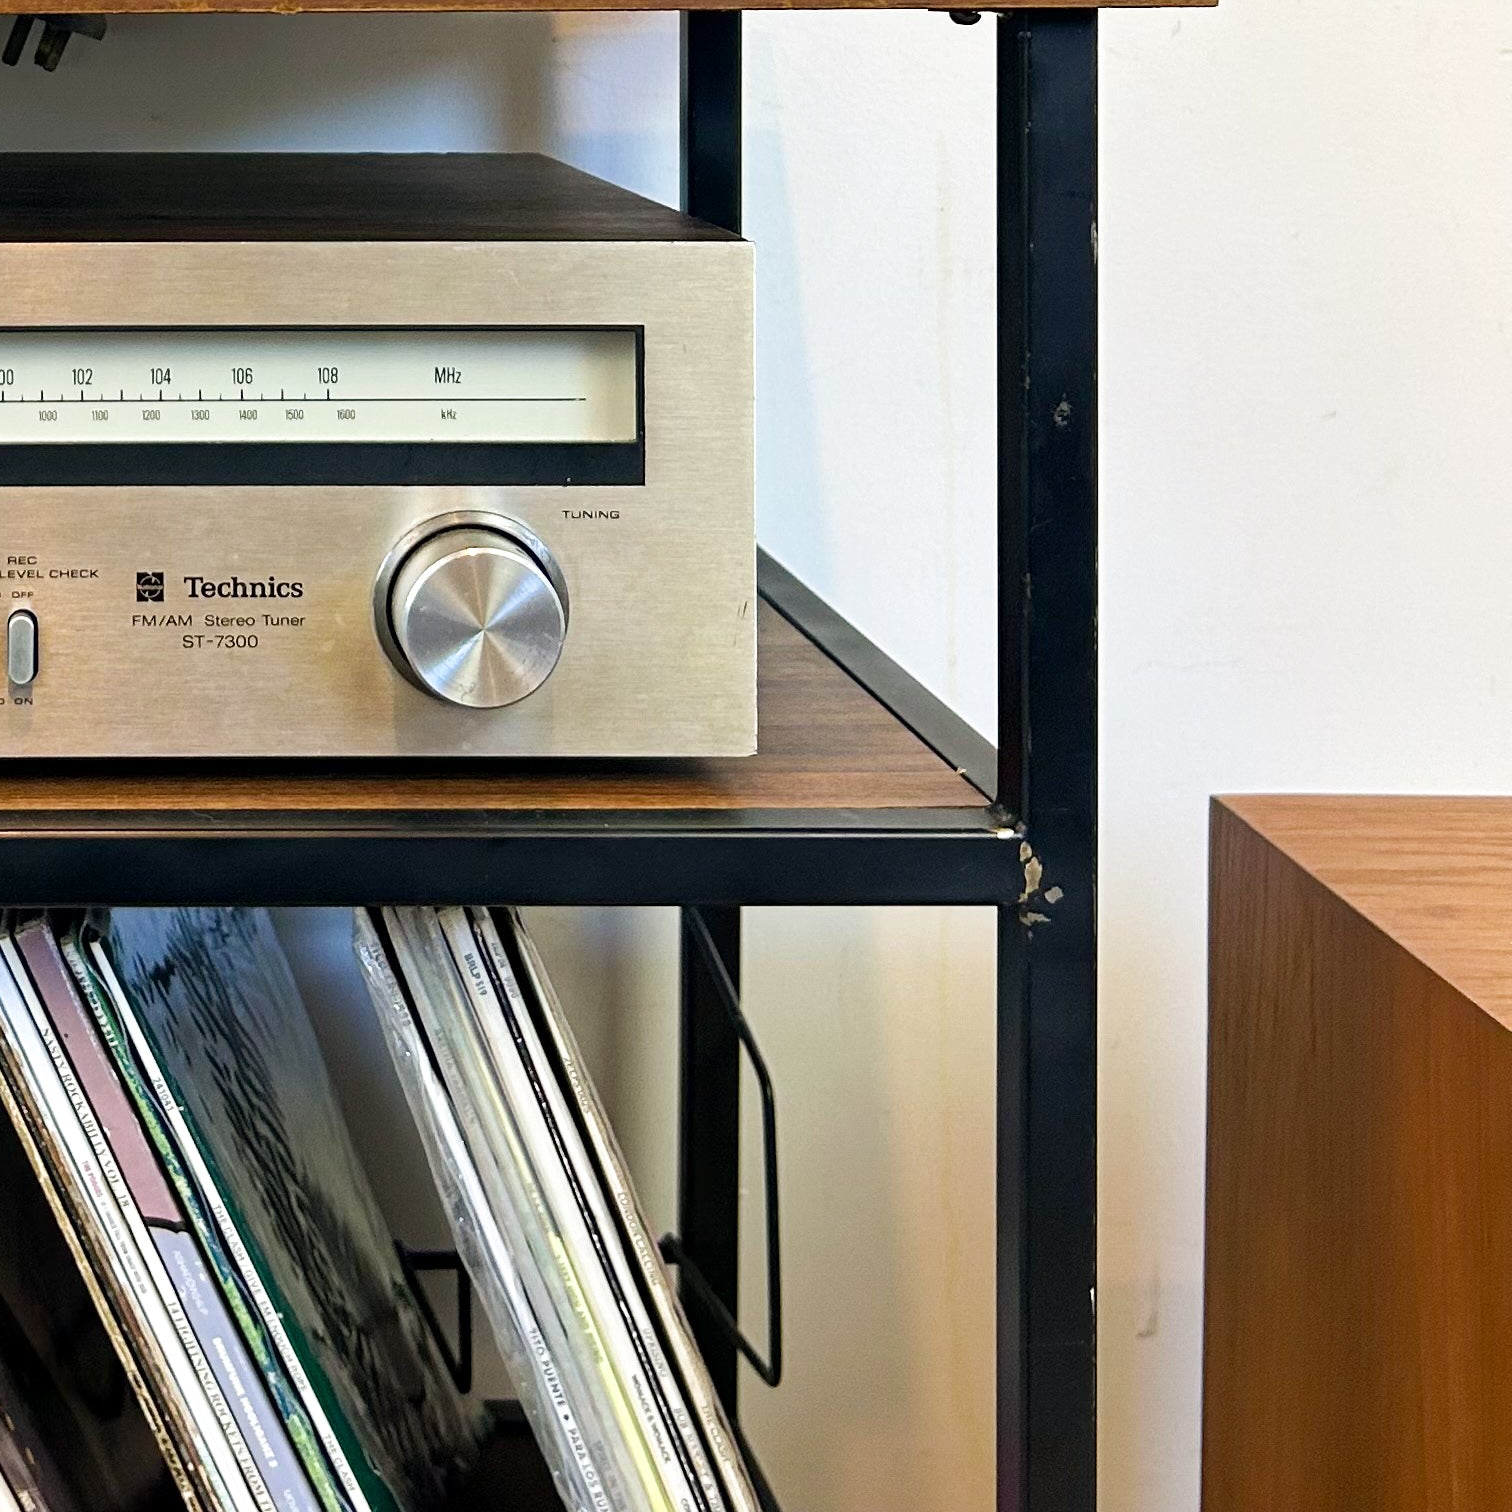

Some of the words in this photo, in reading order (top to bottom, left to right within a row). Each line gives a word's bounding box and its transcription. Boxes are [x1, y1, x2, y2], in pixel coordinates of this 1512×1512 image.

[72, 369, 92, 385] 102
[151, 368, 171, 384] 104
[232, 368, 252, 384] 106
[318, 367, 338, 383] 108
[435, 367, 461, 383] MHz
[38, 409, 58, 422] 1000
[91, 409, 109, 422] 1100
[141, 409, 161, 421] 1200
[190, 409, 210, 421] 1300
[238, 409, 258, 421] 1400
[285, 408, 305, 421] 1500
[336, 408, 356, 421] 1600
[440, 408, 457, 420] kHz
[561, 510, 620, 520] TUNING
[7, 555, 38, 566] REC
[48, 569, 100, 579] CHECK
[11, 590, 35, 599] OFF
[184, 576, 303, 598] Technics
[132, 614, 193, 627] FM/AM
[204, 614, 256, 628] Stereo
[261, 614, 306, 627] Tuner
[183, 635, 258, 648] ST-7300
[13, 697, 34, 706] ON
[152, 1076, 174, 1111] 241041
[40, 1027, 67, 1071] NASTY
[60, 1072, 107, 1159] ROCKABILLY
[117, 1193, 130, 1208] 18
[212, 1203, 228, 1225] THE
[223, 1225, 245, 1262] CLASH
[243, 1268, 261, 1295] GIVE
[266, 1317, 293, 1363] ENOUGH
[289, 1364, 307, 1391] ROPE
[540, 1359, 566, 1407] PUENTE
[567, 1427, 587, 1461] PARA
[581, 1462, 598, 1488] LOS
[629, 1374, 651, 1415] WOMACK
[649, 1422, 672, 1464] WOMACK
[323, 1433, 338, 1455] THE
[333, 1456, 356, 1492] CLASH
